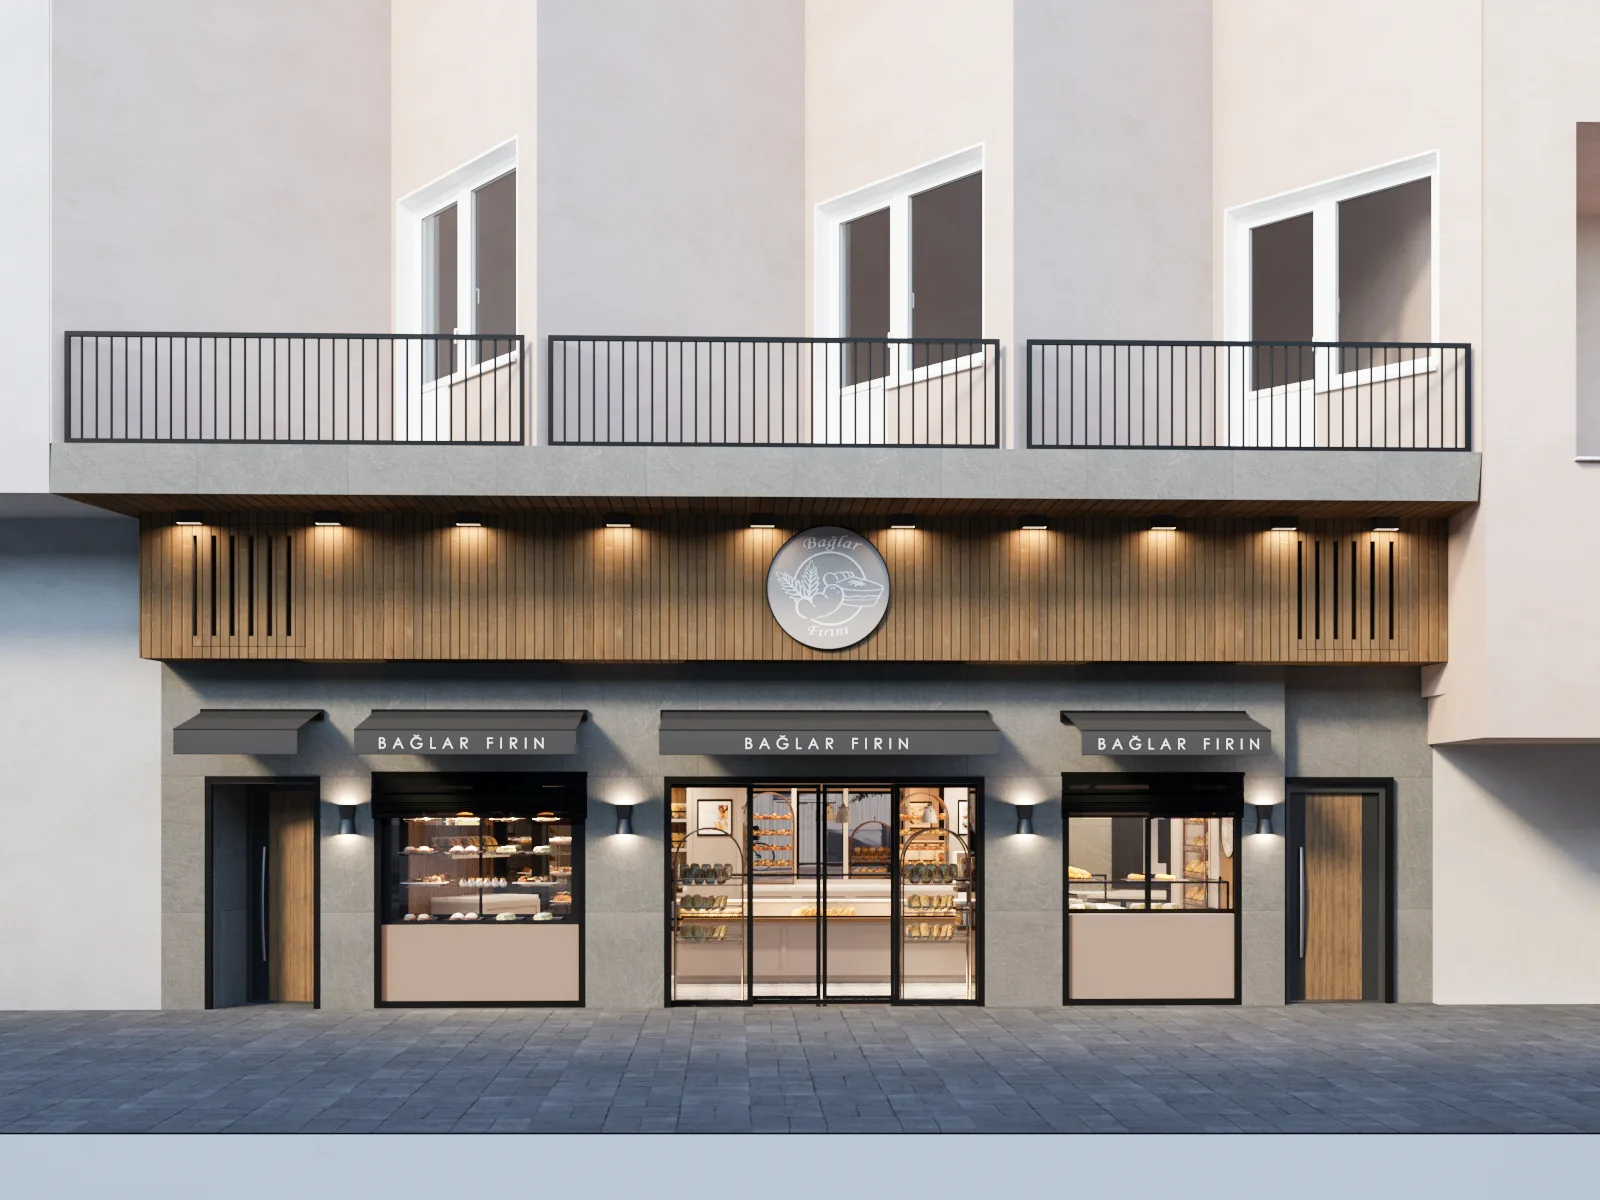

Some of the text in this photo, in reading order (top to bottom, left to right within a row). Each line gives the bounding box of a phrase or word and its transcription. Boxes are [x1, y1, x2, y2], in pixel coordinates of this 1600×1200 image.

[803, 535, 862, 551] Bağlar
[378, 734, 546, 750] BAĞLAR FIRIN
[744, 734, 909, 750] BAĞLAR FIRIN
[1097, 735, 1260, 751] BAĞLAR FIRIN
